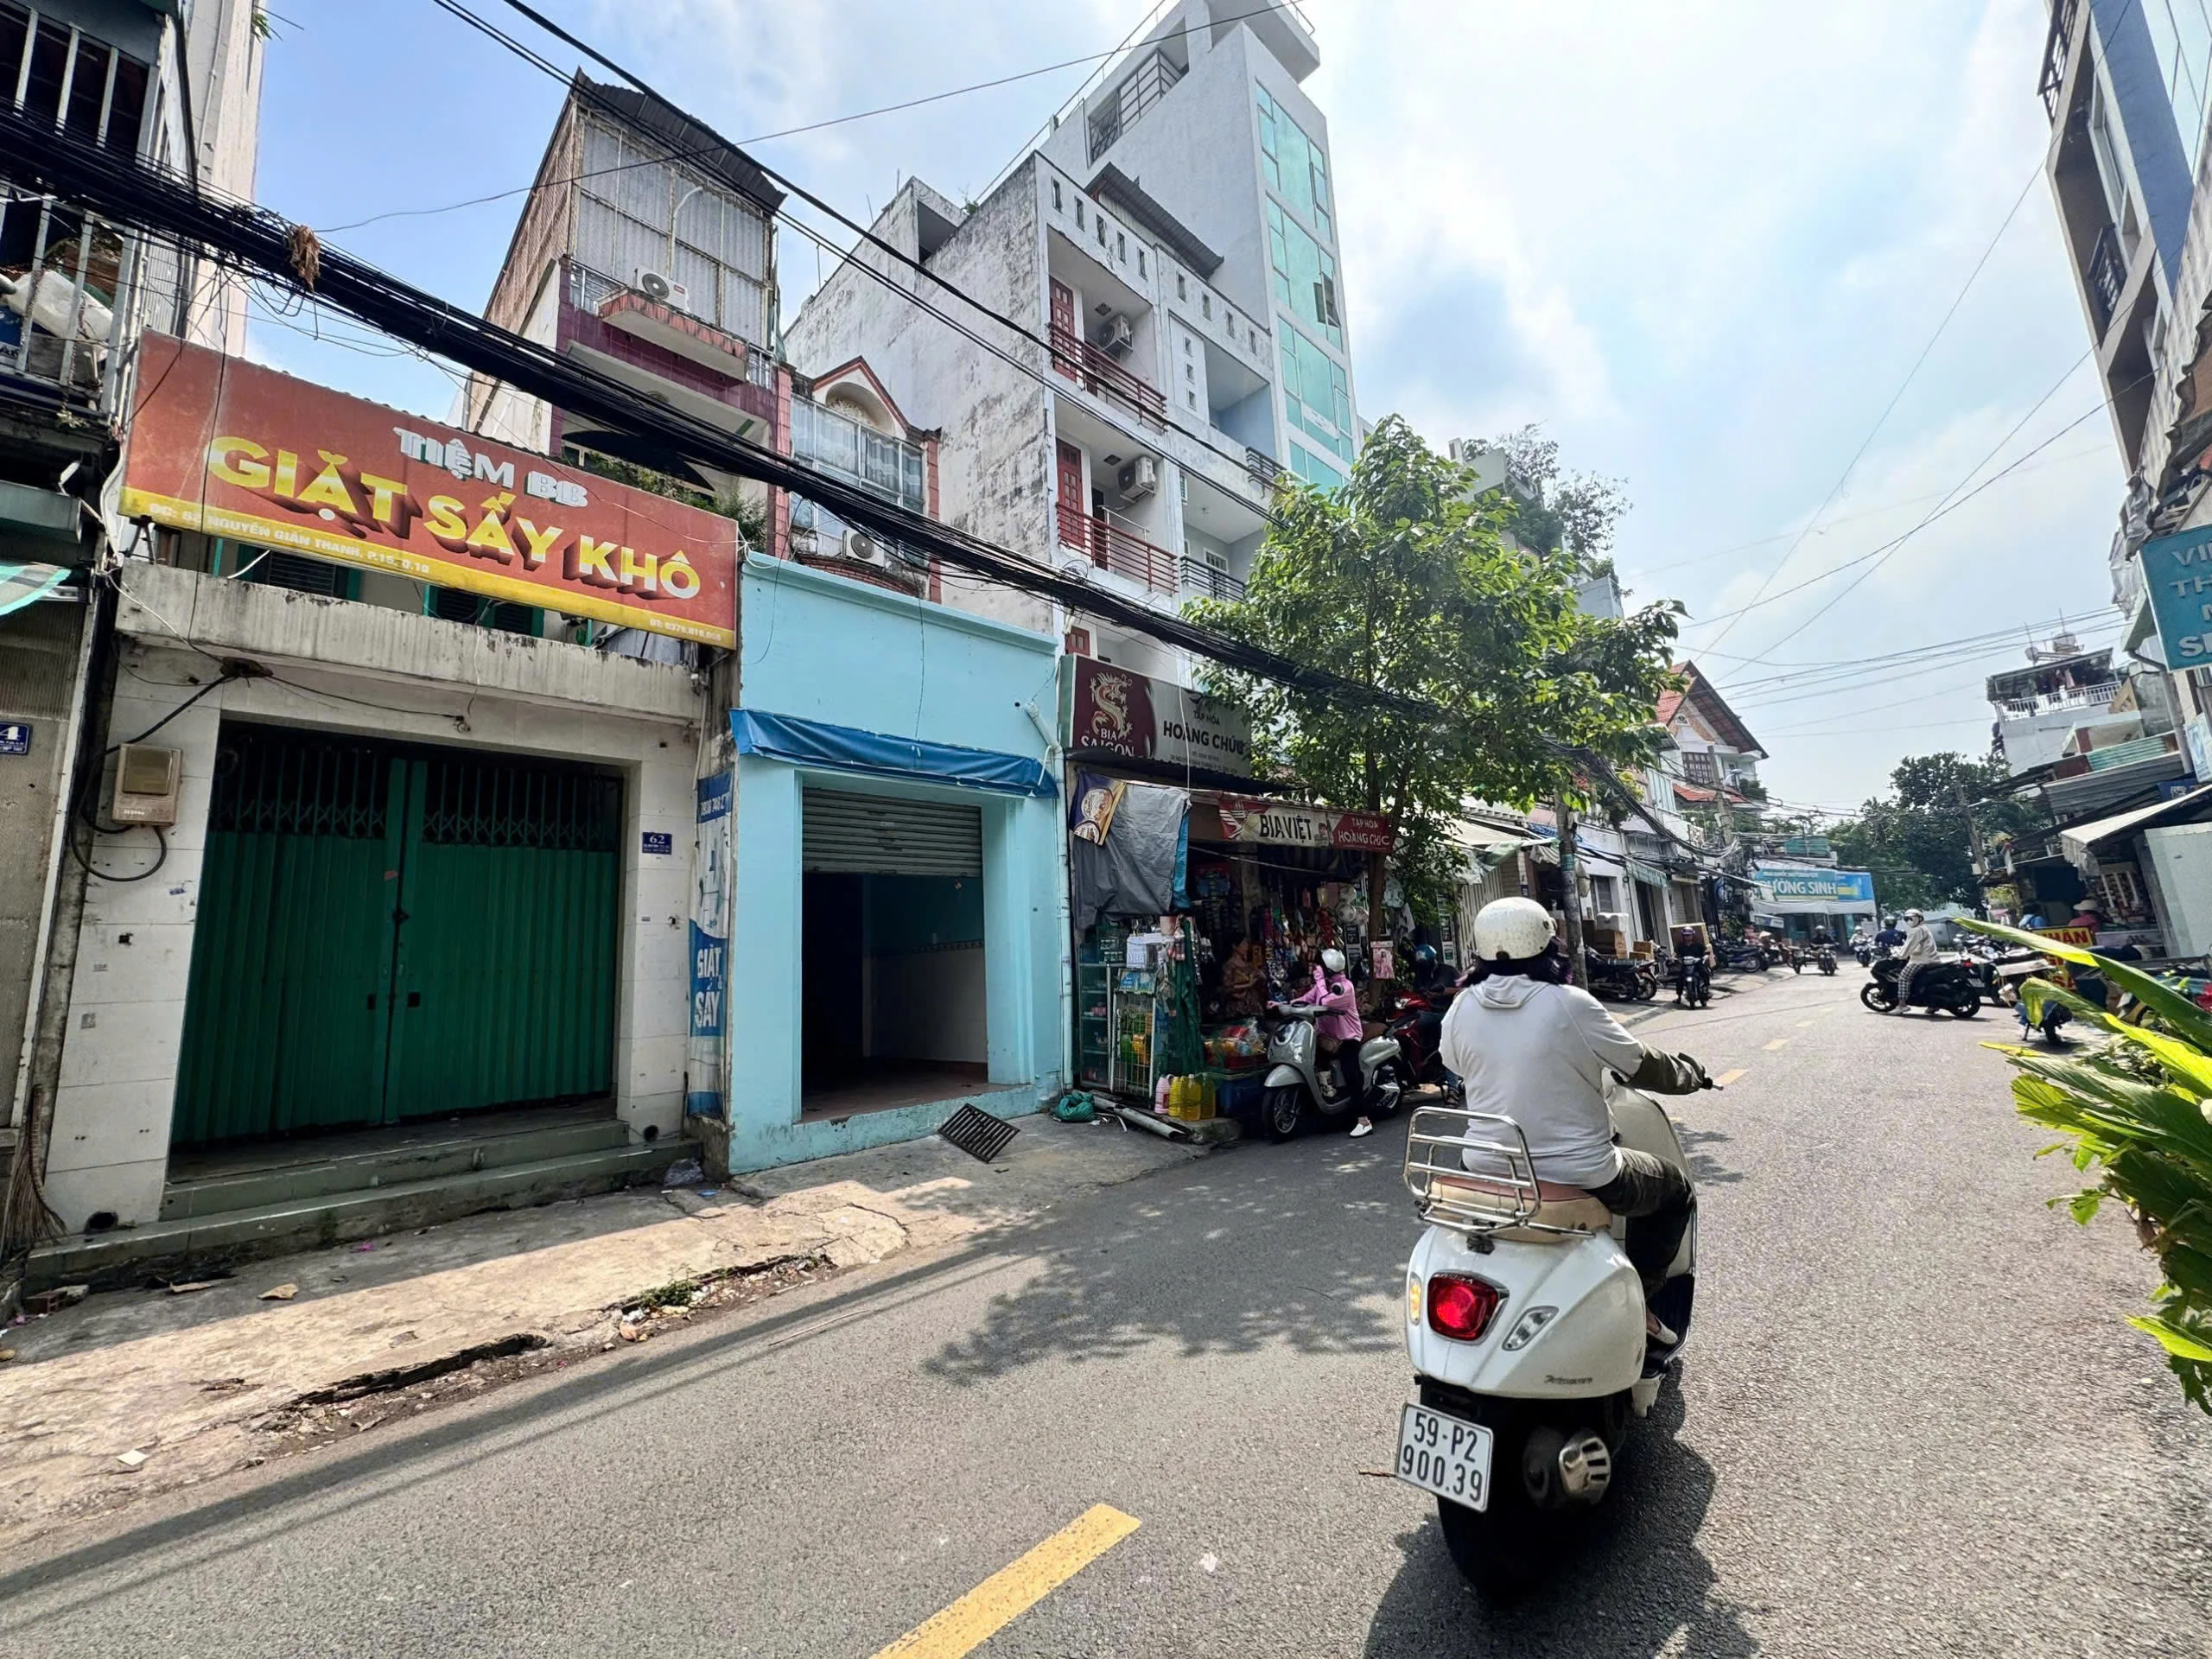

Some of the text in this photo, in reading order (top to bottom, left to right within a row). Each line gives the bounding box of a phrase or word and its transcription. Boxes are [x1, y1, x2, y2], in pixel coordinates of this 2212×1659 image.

[393, 427, 588, 507] TIỆM BB
[202, 435, 701, 600] GIẶT SẤY KHÔ
[1100, 728, 1117, 741] BIA
[1163, 720, 1210, 746] HOÀNG
[649, 835, 665, 844] 62
[1259, 814, 1313, 844] BIA VIỆT
[1808, 880, 1837, 895] SINH
[1402, 1444, 1484, 1503] 900.39
